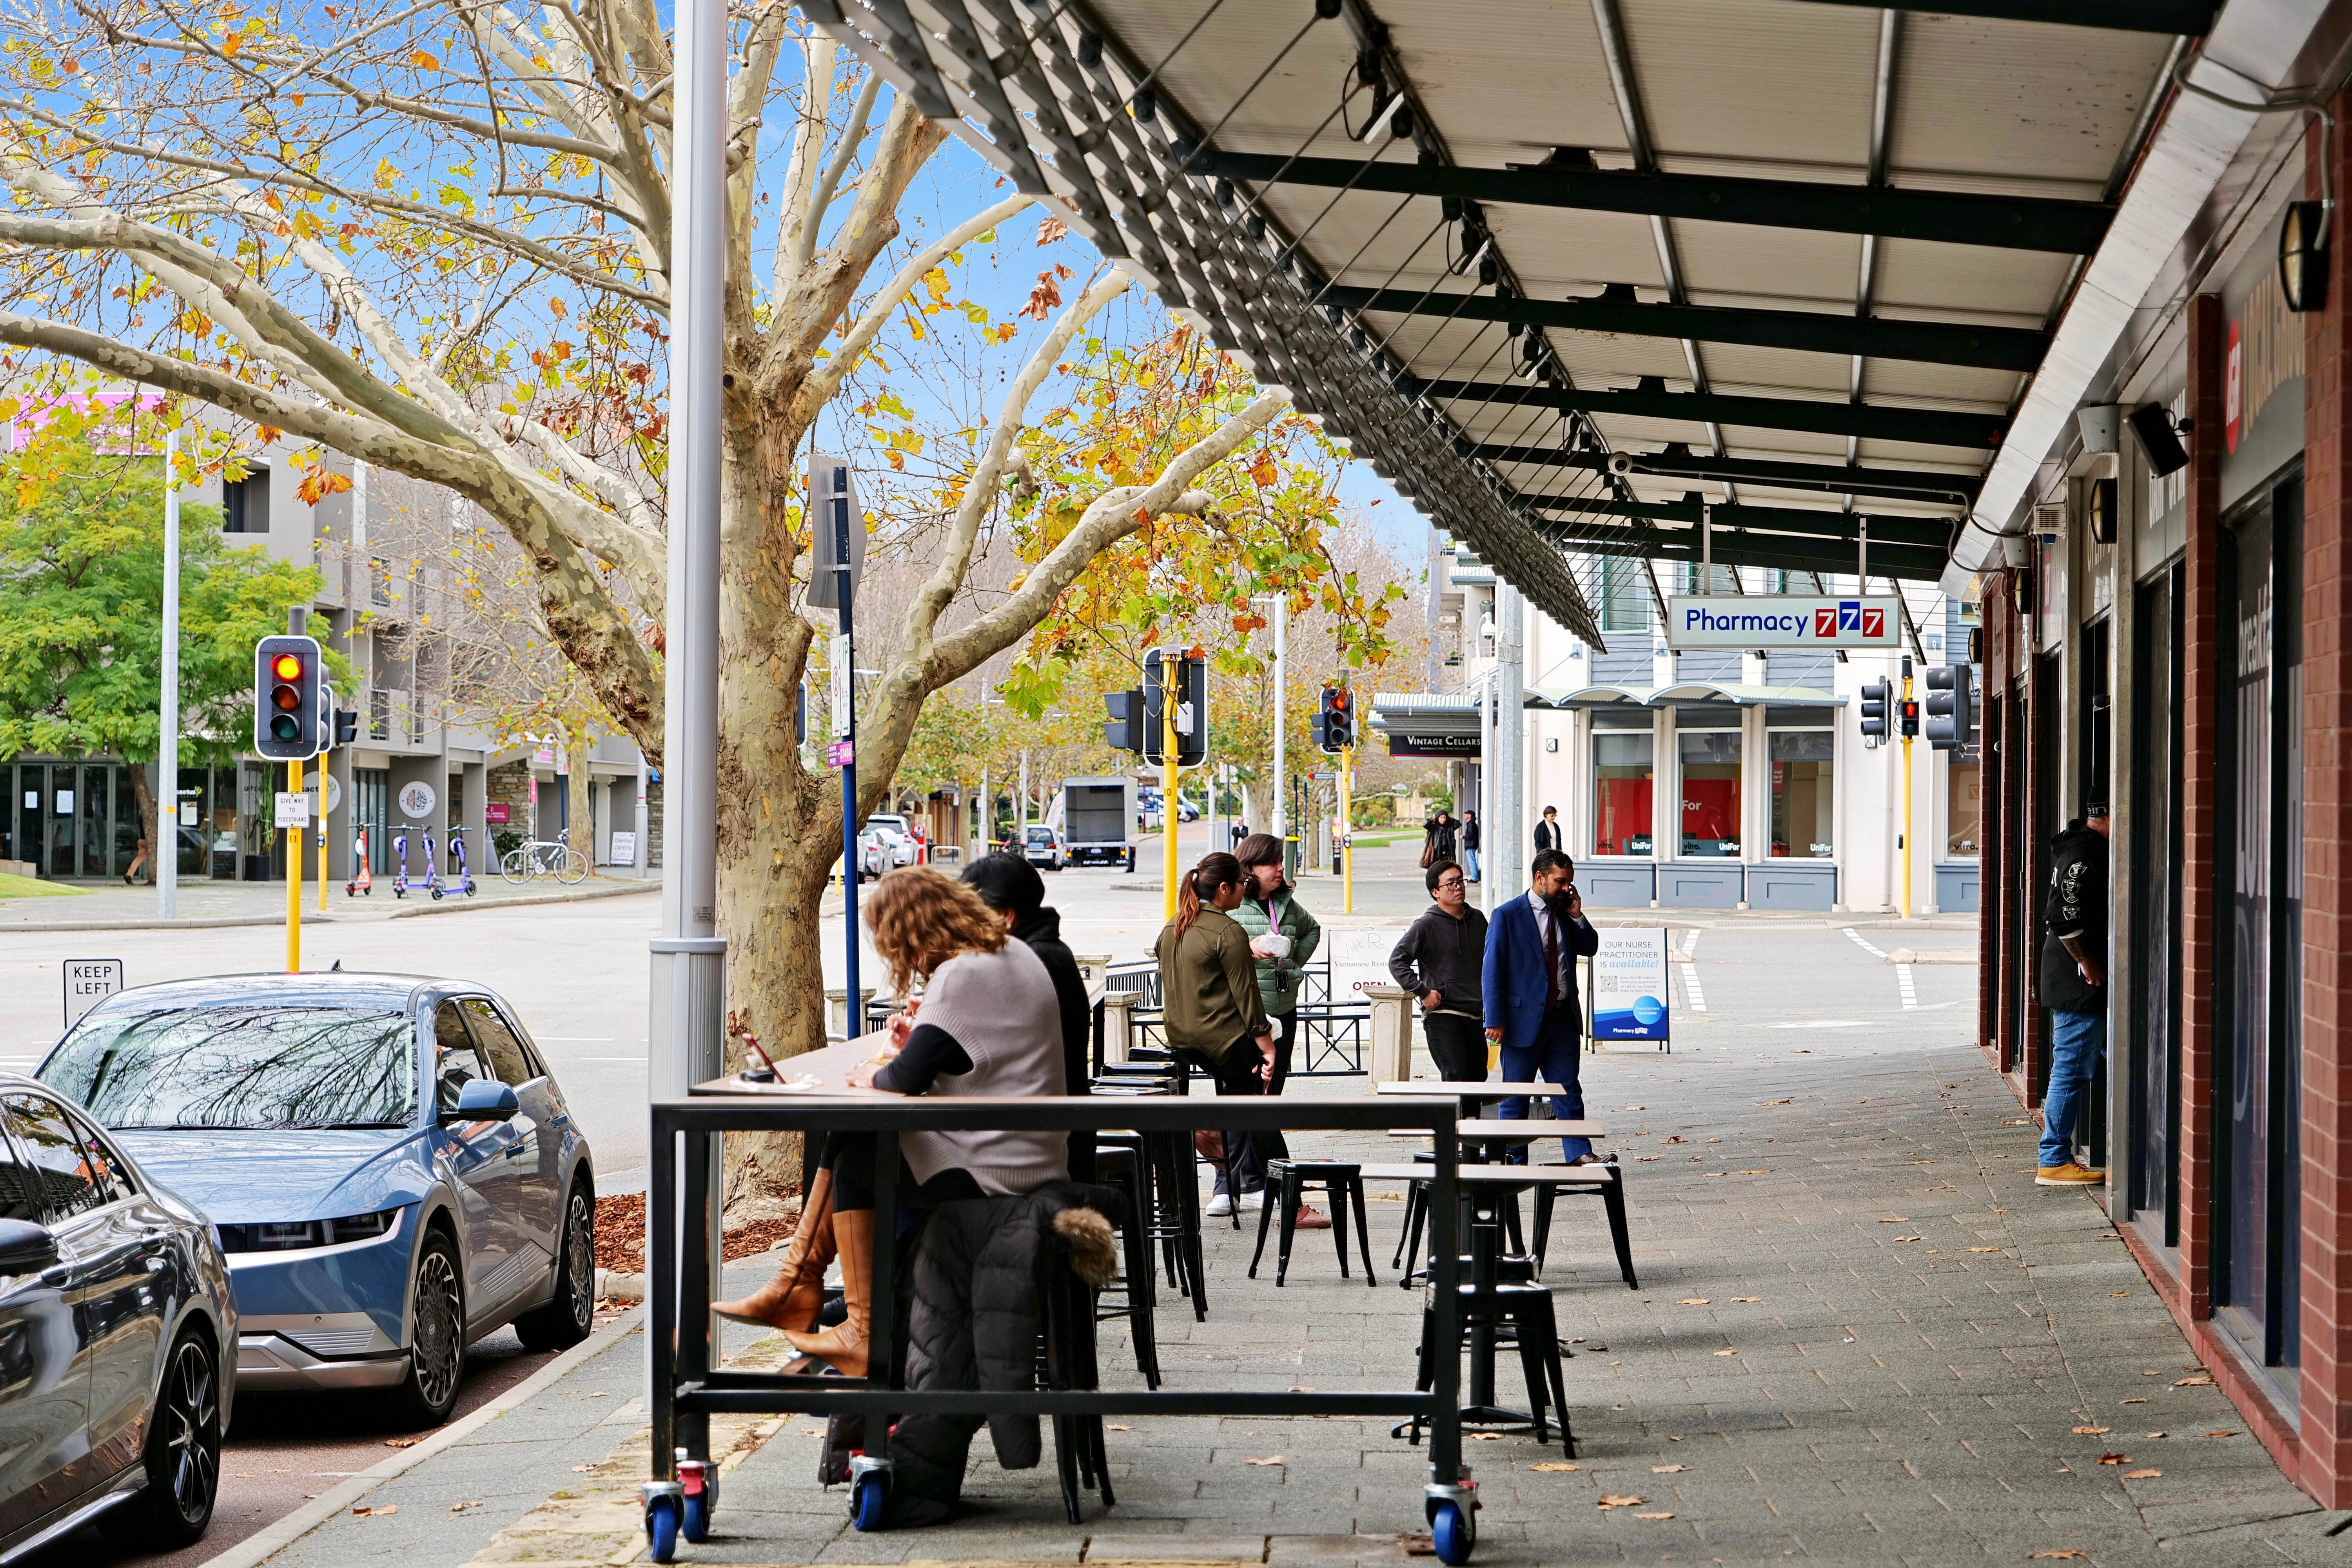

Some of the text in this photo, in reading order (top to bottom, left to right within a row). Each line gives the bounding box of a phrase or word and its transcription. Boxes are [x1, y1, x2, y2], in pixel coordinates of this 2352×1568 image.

[1686, 608, 1883, 637] Pharmacy 777
[1407, 735, 1481, 745] VINTAGE CELLARS
[1632, 842, 1652, 850] UniFor
[1683, 842, 1700, 850] vitra.
[1719, 843, 1740, 851] UniFor
[1810, 843, 1832, 852] UniFor
[1609, 960, 1659, 968] available!
[74, 966, 112, 978] KEEP
[76, 983, 111, 994] LEFT
